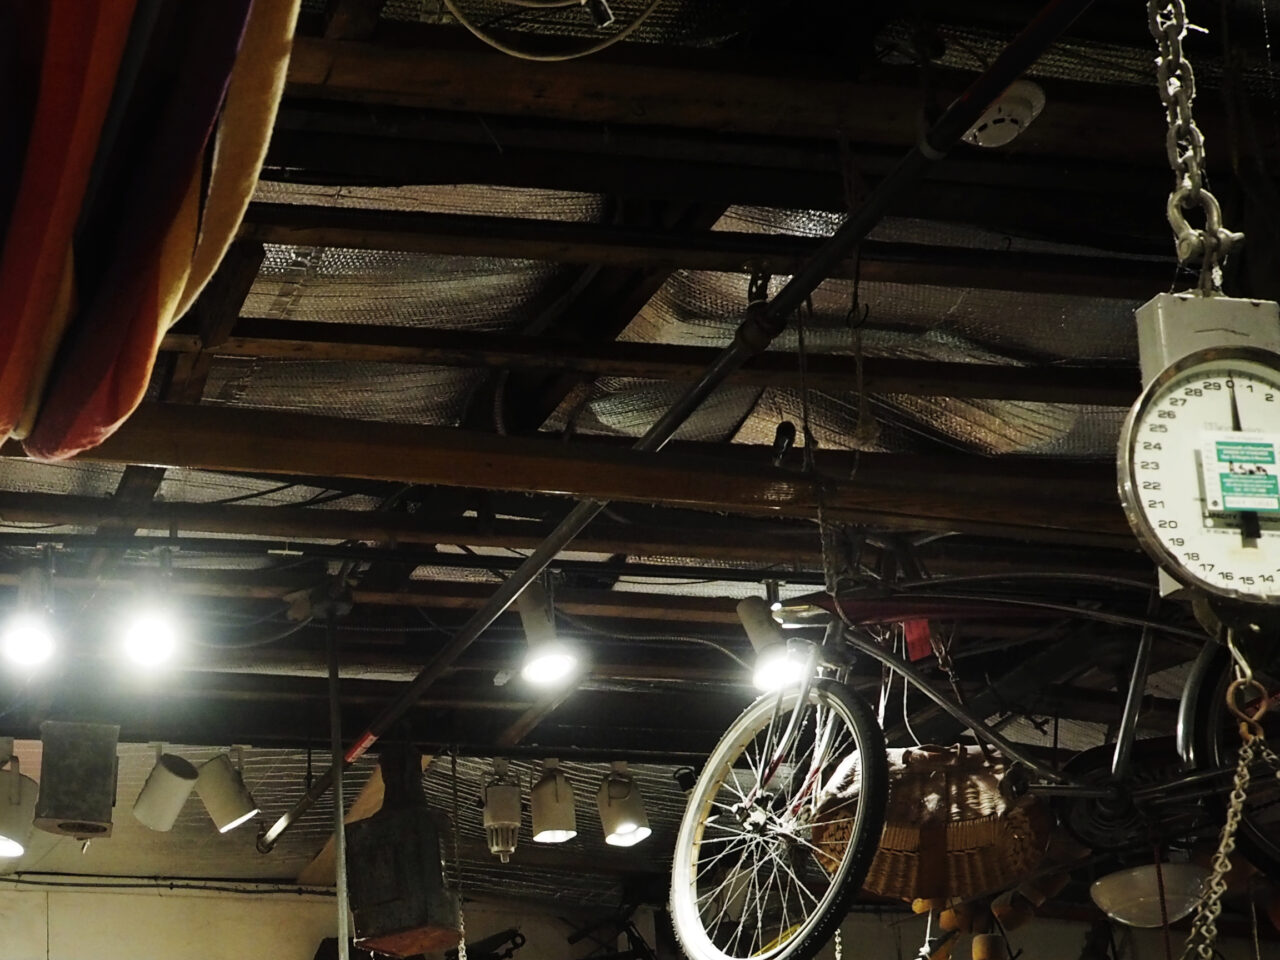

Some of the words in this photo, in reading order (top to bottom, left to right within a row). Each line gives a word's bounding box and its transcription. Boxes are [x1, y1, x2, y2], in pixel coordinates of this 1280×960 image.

[1202, 381, 1222, 391] 29
[1184, 387, 1204, 397] 28
[1169, 397, 1187, 407] 27
[1265, 393, 1275, 402] 2
[1157, 410, 1177, 419] 26
[1148, 424, 1168, 433] 25
[1143, 441, 1163, 451] 24
[1140, 461, 1160, 470] 23
[1142, 481, 1161, 490] 22
[1148, 500, 1165, 508] 21
[1158, 520, 1178, 529] 20
[1168, 538, 1185, 547] 19
[1184, 552, 1200, 561] 18
[1199, 564, 1215, 572] 17
[1218, 572, 1234, 581] 16
[1239, 576, 1255, 585] 15
[1258, 575, 1275, 583] 14
